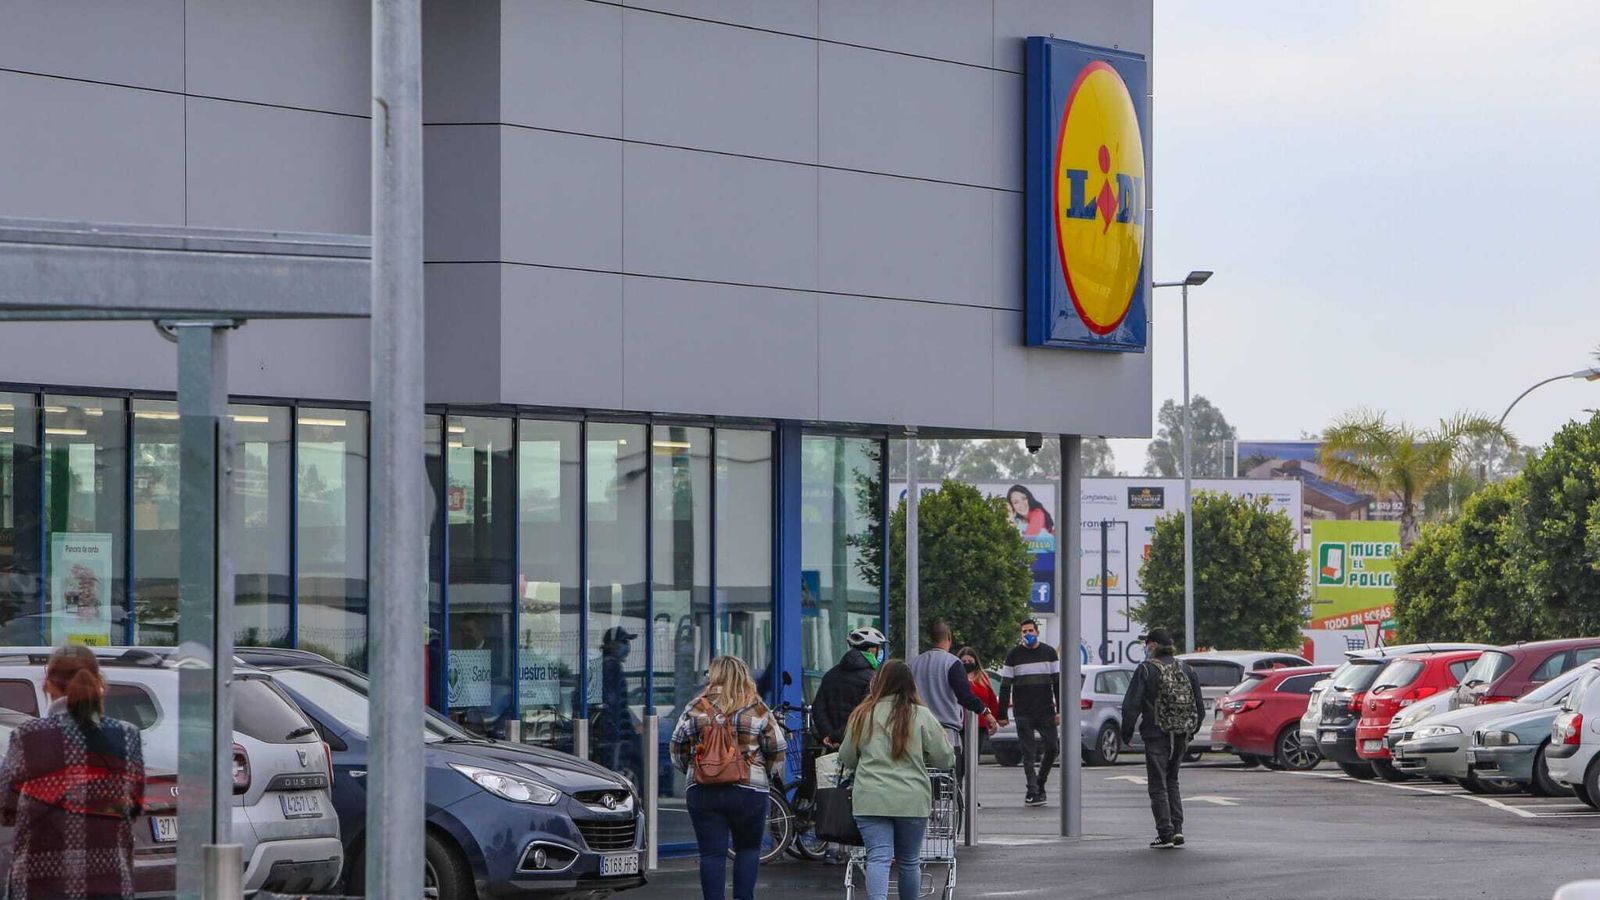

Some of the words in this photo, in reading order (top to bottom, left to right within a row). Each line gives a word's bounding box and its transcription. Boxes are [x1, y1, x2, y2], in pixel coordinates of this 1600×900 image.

[1351, 543, 1397, 557] MUEB
[1353, 560, 1364, 568] EL
[1324, 616, 1349, 630] TODO
[1350, 613, 1362, 626] EN
[285, 777, 324, 787] DUSTER
[604, 856, 622, 873] 6168
